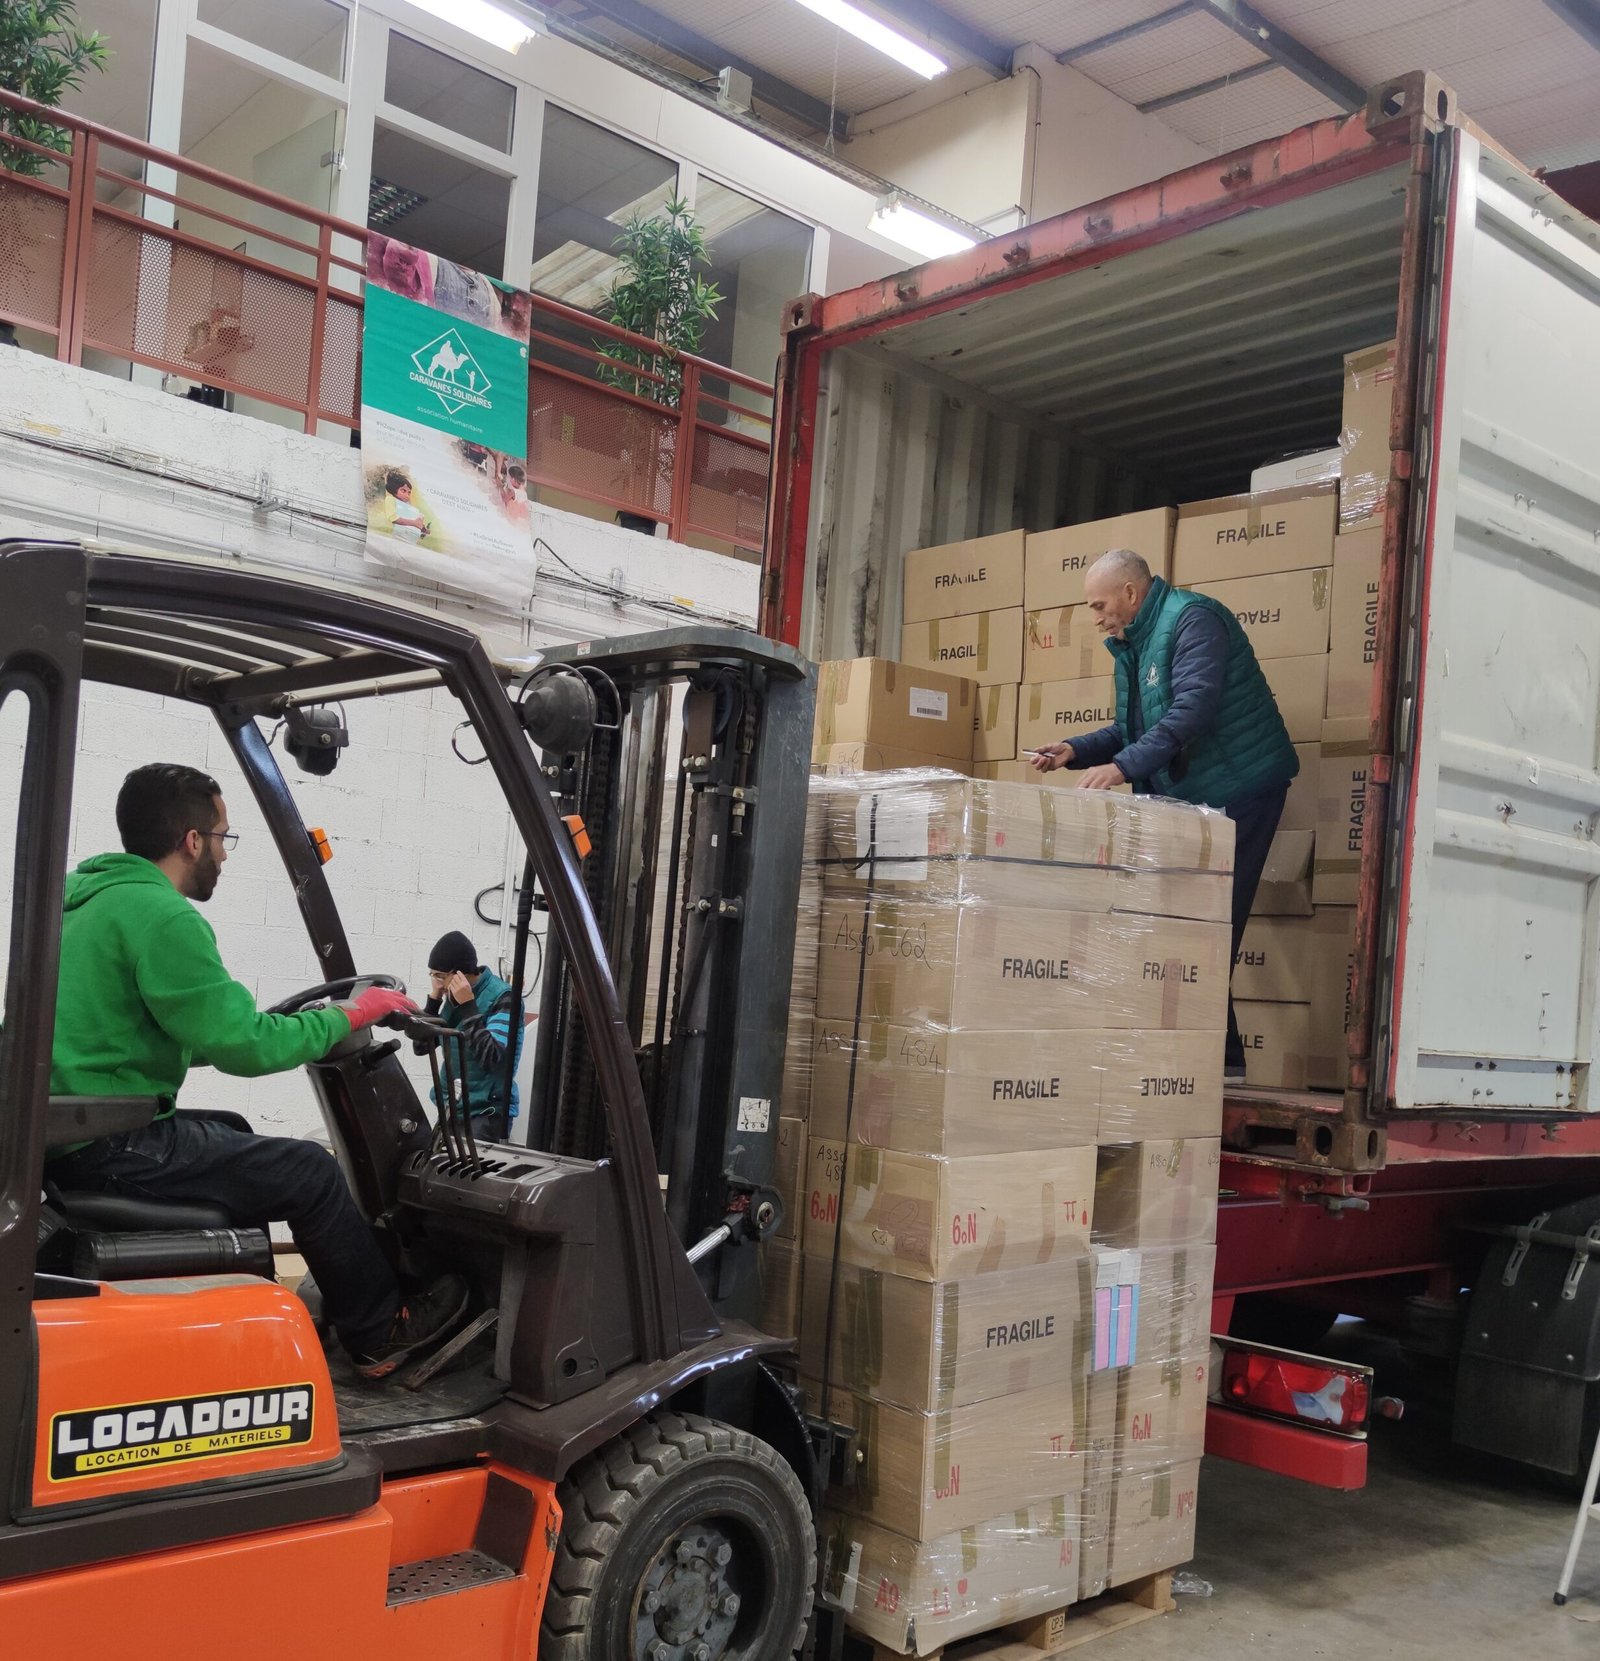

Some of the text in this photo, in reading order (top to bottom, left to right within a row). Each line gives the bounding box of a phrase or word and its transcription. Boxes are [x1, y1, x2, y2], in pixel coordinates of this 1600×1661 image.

[410, 372, 492, 409] CARAVANES SOLIDAIRES
[416, 406, 483, 434] association humanitaire
[1002, 958, 1069, 980] FRAGILE
[900, 1034, 941, 1074] 484
[993, 1078, 1060, 1101] FRAGILE
[1141, 1077, 1195, 1097] FRAGILE
[986, 1316, 1055, 1348] FRAGILE
[57, 1390, 310, 1455] LOCADOUR
[86, 1429, 282, 1467] LOCATION DE MATERIELS
[1051, 1616, 1064, 1631] CP3
